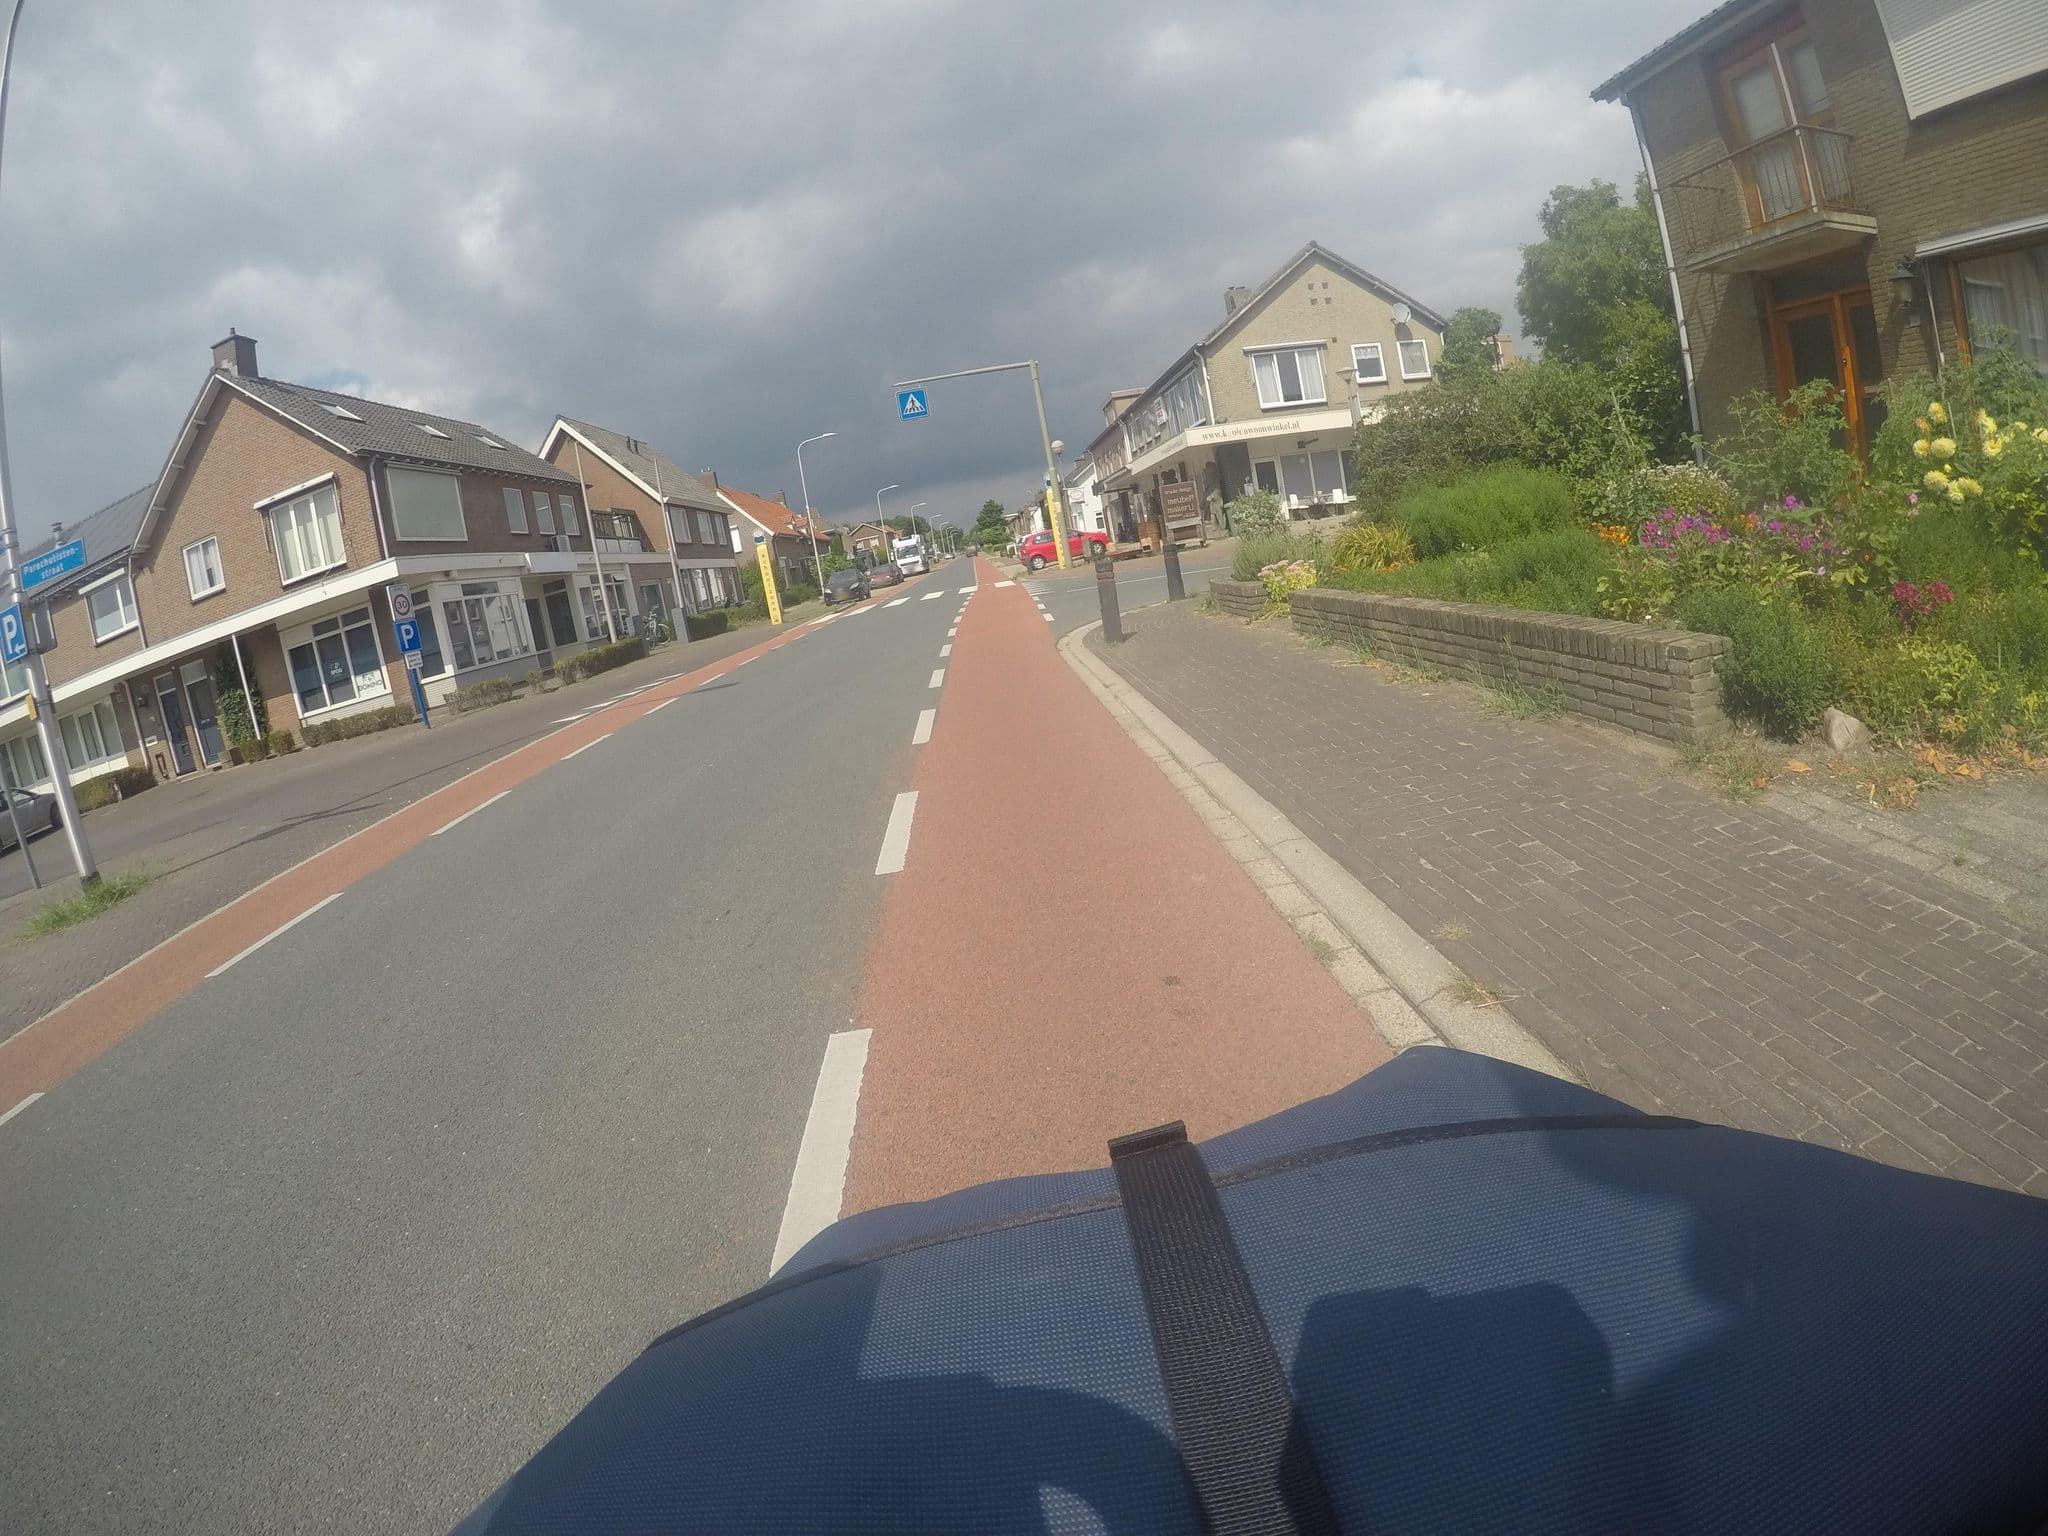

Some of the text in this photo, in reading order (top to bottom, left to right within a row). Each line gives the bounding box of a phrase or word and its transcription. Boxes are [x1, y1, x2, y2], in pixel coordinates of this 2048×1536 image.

[24, 547, 79, 575] Parachutisten-
[41, 563, 64, 579] straat
[396, 601, 408, 610] 30
[2, 614, 17, 654] P
[400, 624, 414, 649] P
